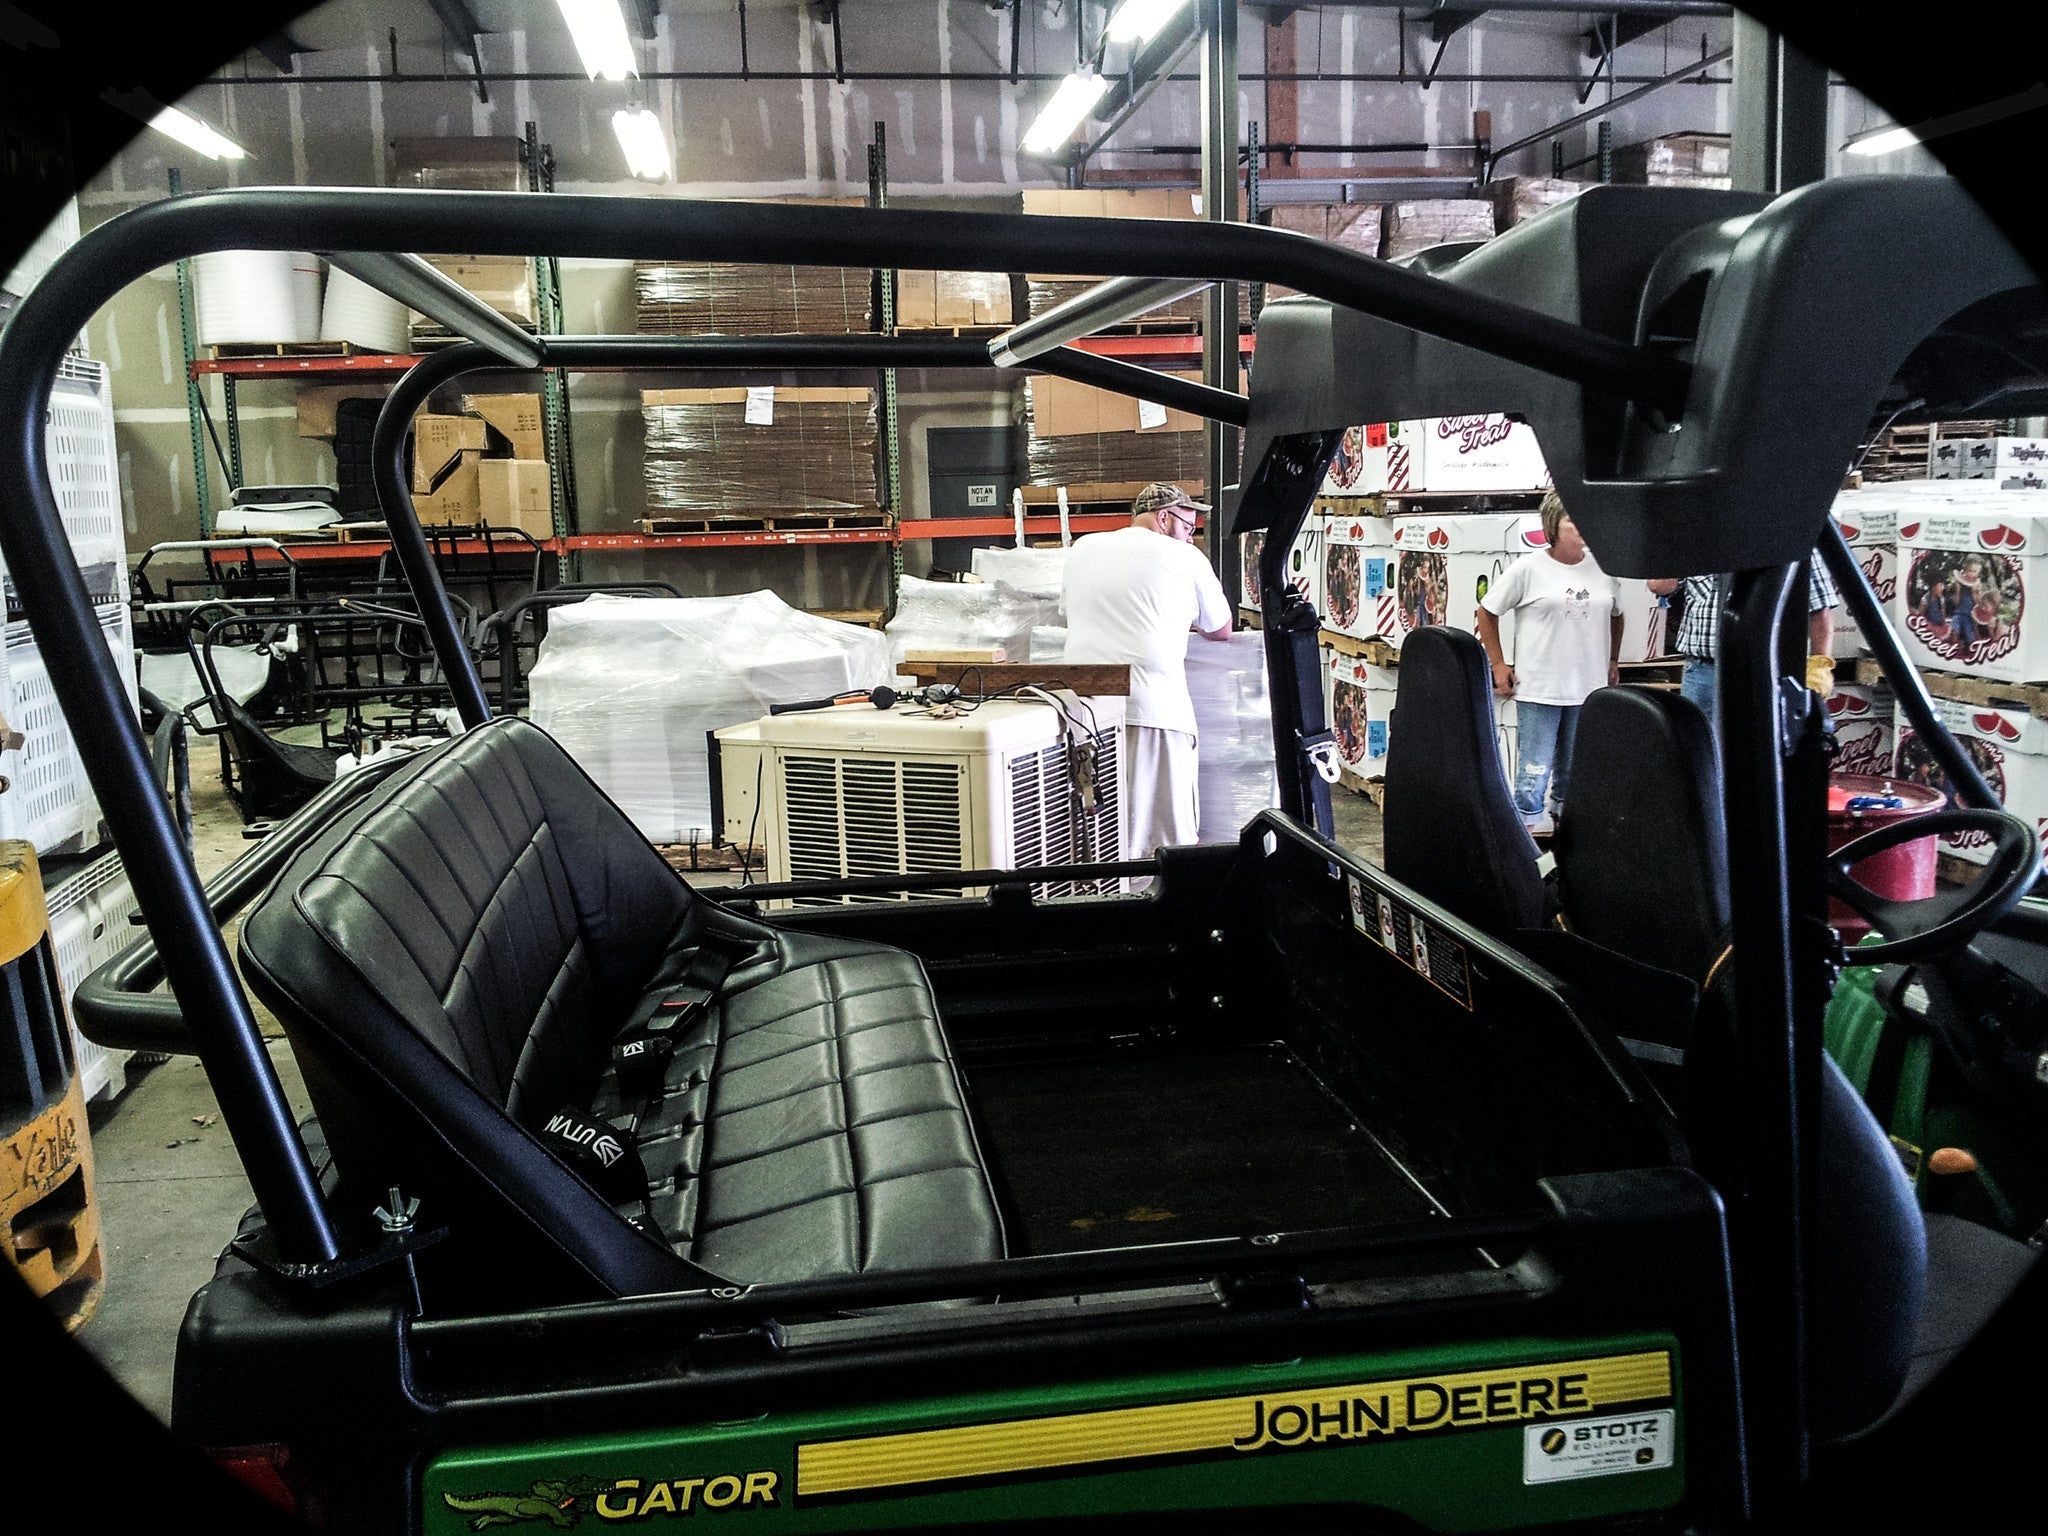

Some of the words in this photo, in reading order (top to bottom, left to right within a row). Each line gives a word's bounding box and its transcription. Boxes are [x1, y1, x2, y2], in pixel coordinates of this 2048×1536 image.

[1459, 418, 1512, 454] Treat
[971, 487, 983, 495] NOT
[976, 495, 989, 503] EXIT
[1906, 613, 1959, 661] Sweet
[1963, 624, 2020, 665] Treat
[1233, 1394, 1390, 1447] JOHN
[1405, 1373, 1590, 1426] DEERE
[1574, 1418, 1659, 1441] STOTZ
[595, 1471, 778, 1519] GATOR
